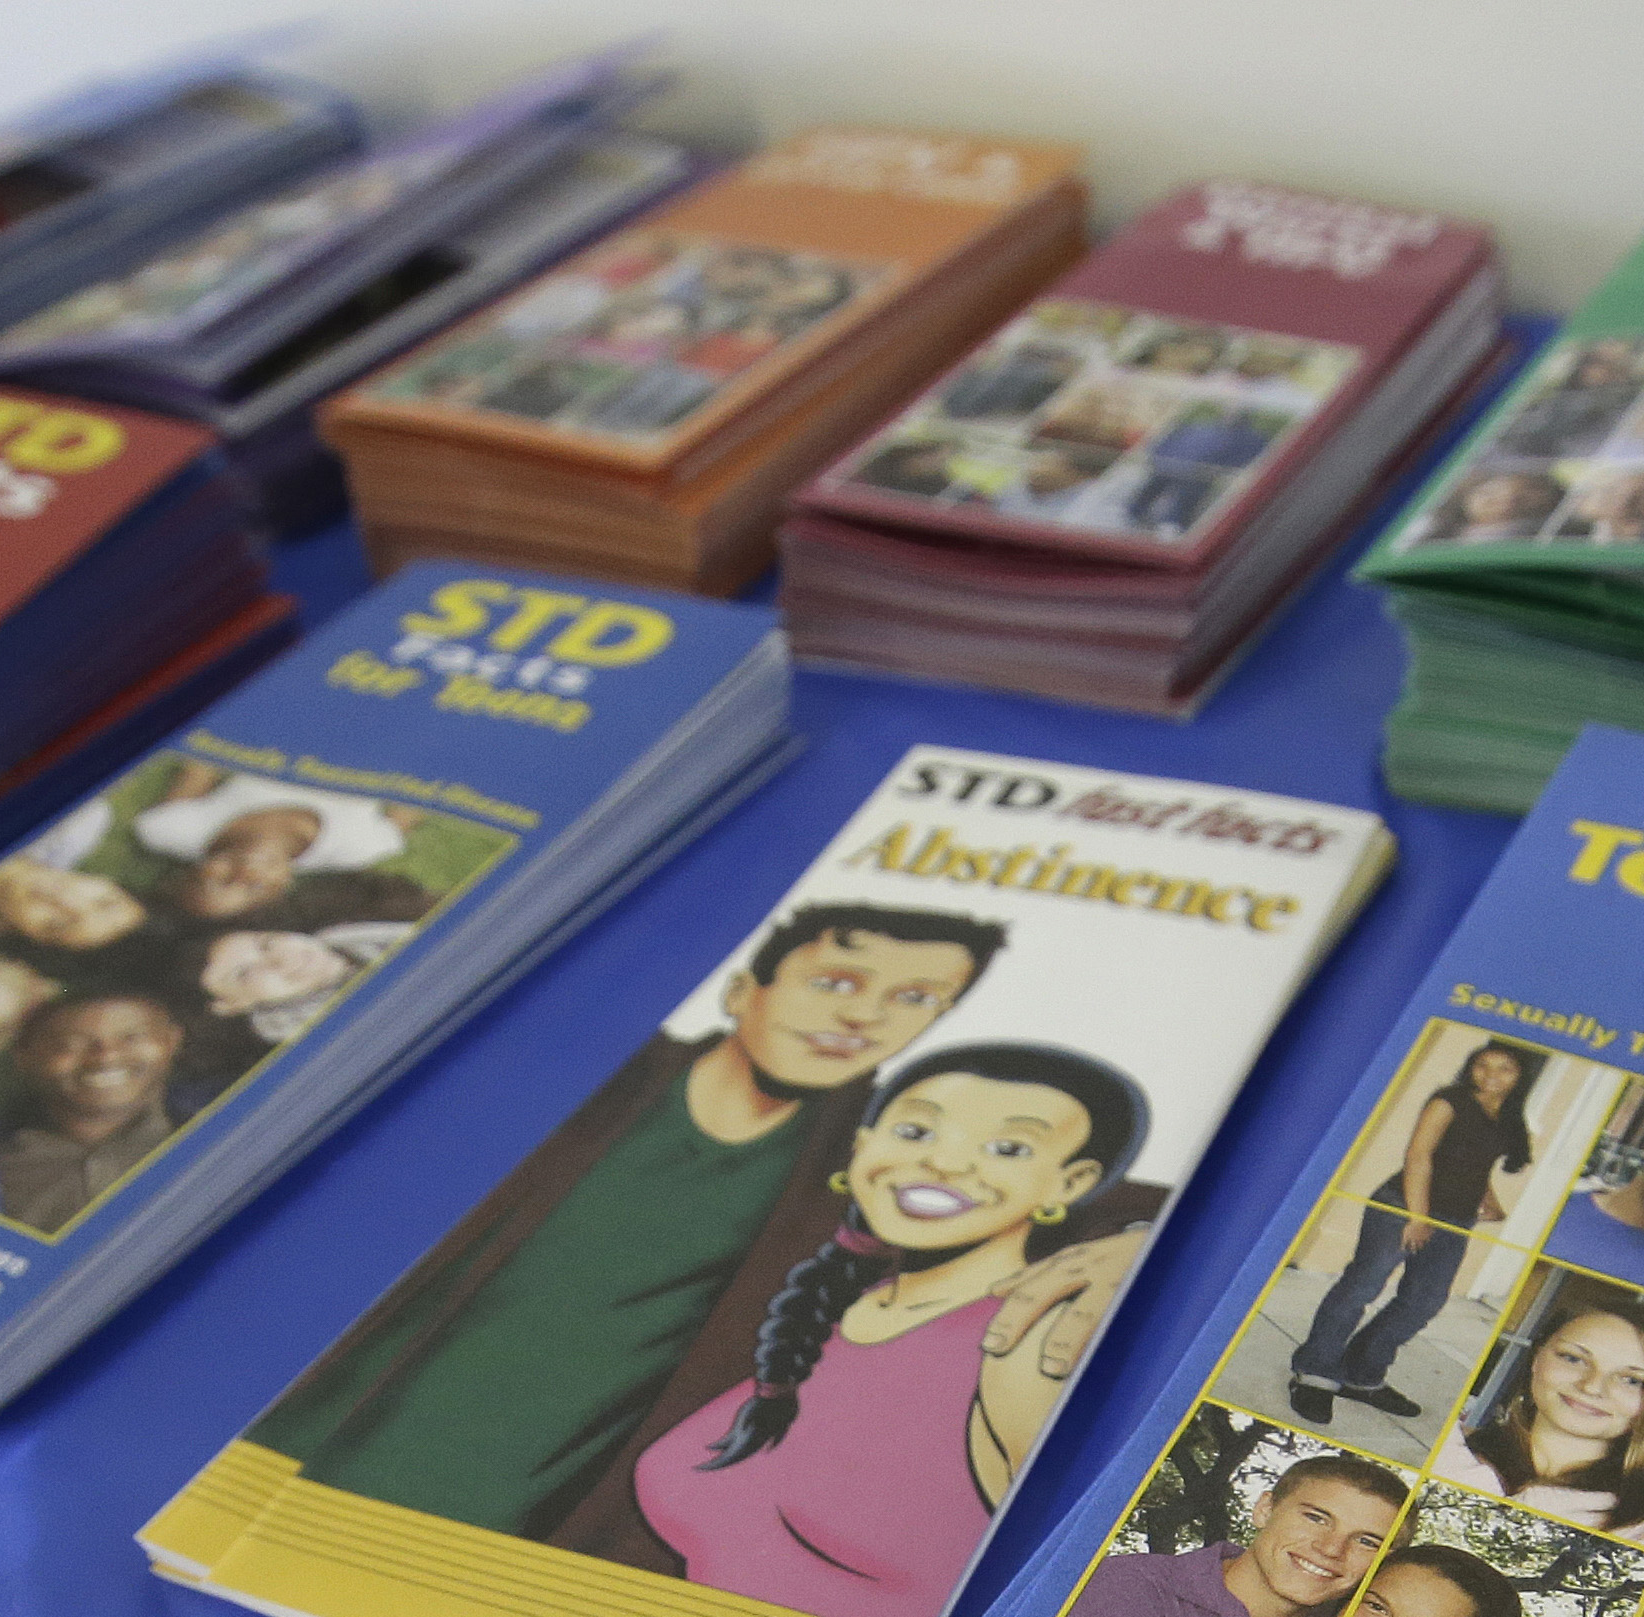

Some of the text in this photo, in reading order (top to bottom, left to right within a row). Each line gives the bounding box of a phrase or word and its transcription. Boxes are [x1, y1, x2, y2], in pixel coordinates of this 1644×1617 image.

[402, 579, 674, 667] STD
[390, 631, 594, 694] Facts
[899, 761, 1057, 810] STD
[844, 820, 1300, 934] Abstinence
[1448, 981, 1618, 1049] Sexually
